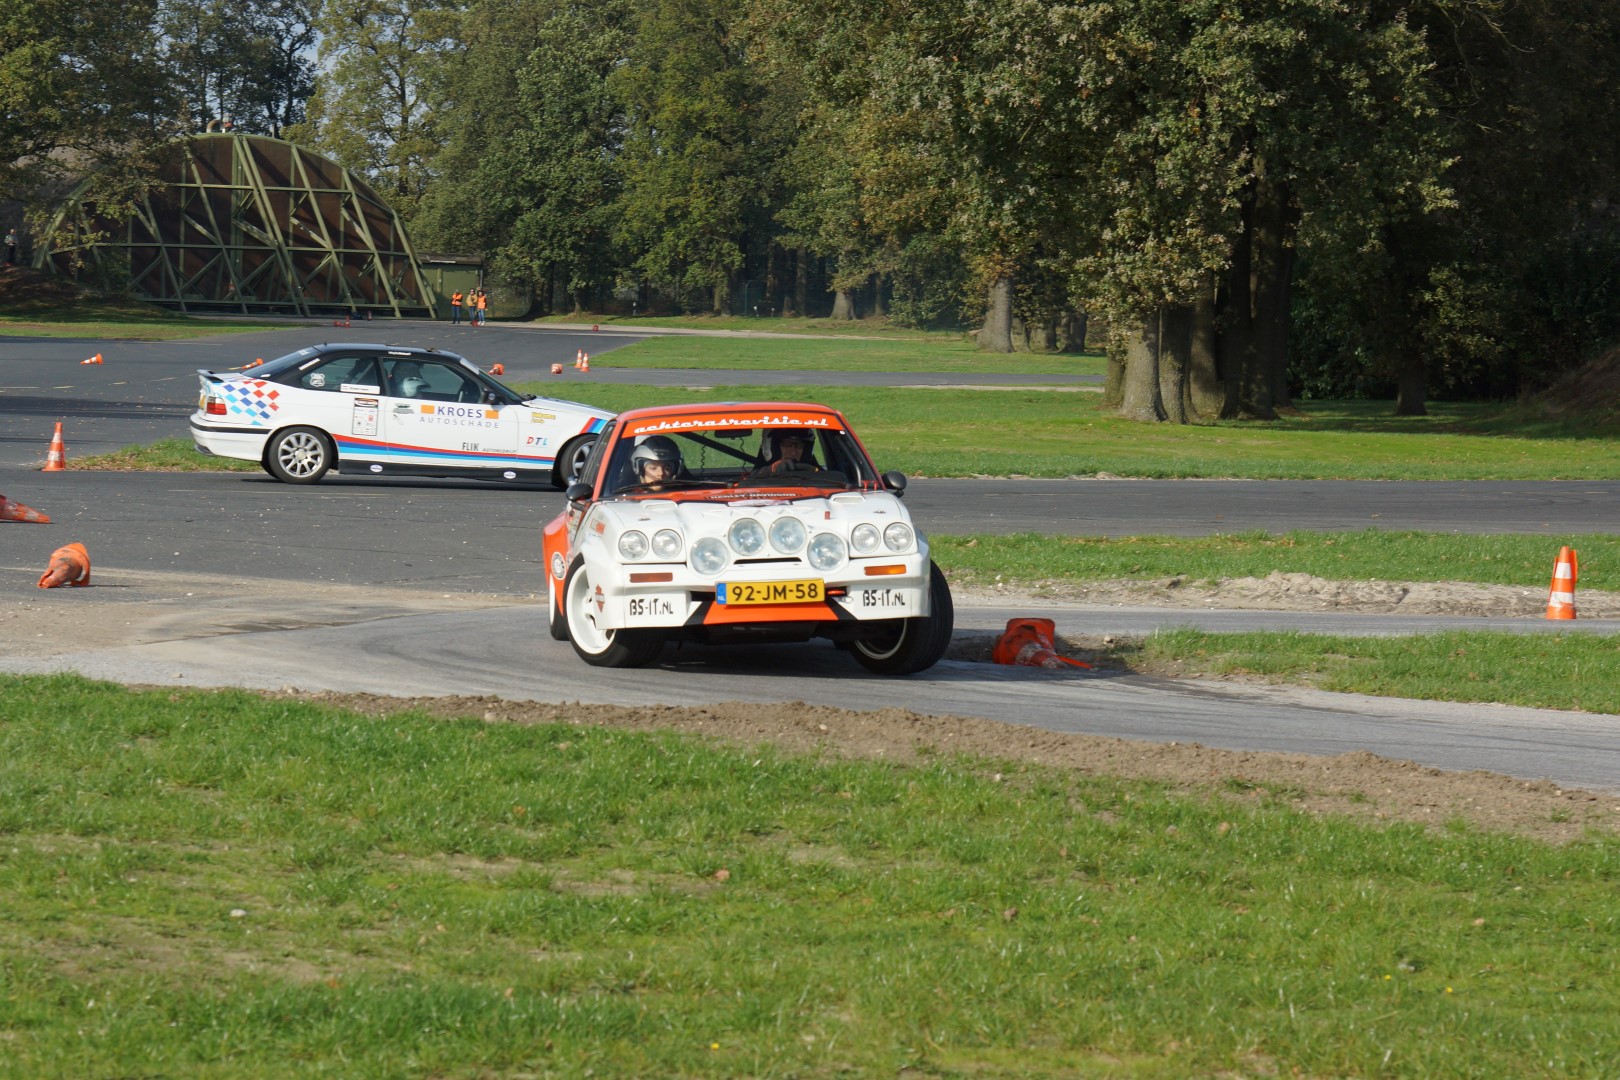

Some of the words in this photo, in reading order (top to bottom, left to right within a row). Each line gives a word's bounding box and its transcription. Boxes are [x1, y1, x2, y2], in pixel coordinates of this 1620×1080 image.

[437, 406, 482, 418] KROES
[420, 416, 499, 428] AUTOSCHADE
[462, 442, 479, 451] FLIK
[526, 436, 548, 446] DTL
[732, 583, 818, 602] 92-JM-58
[863, 589, 905, 606] BS-IT.NL
[629, 599, 673, 616] BS-IT.NL
